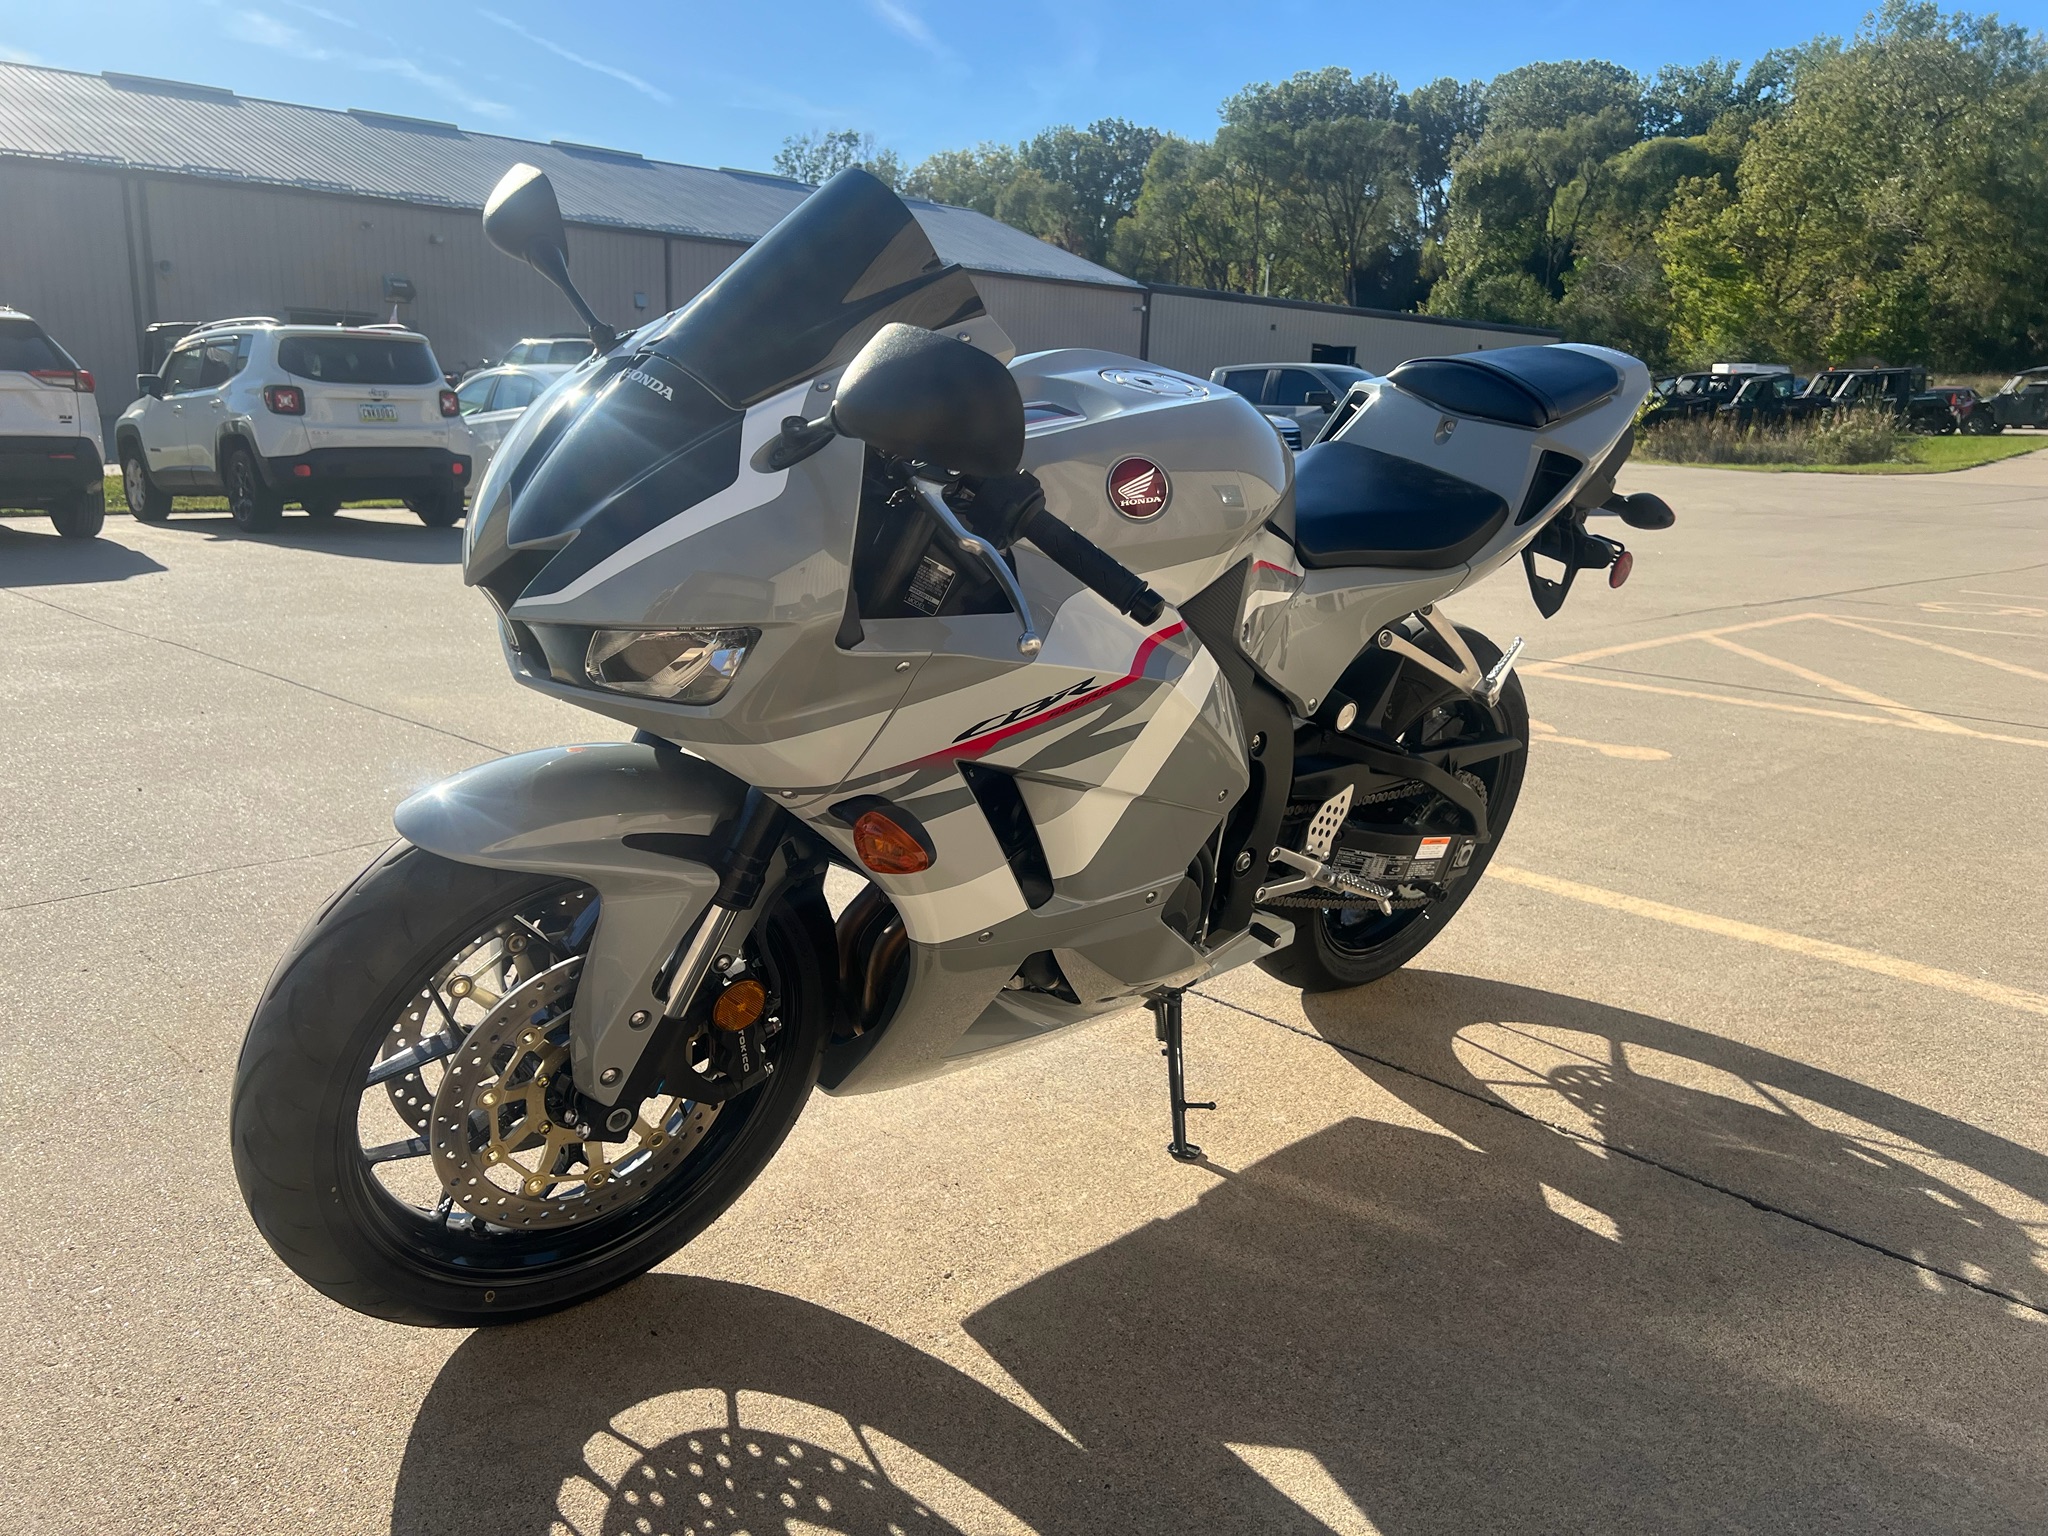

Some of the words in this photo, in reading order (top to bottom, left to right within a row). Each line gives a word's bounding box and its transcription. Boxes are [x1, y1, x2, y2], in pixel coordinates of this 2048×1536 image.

[623, 367, 674, 402] HONDA
[1120, 496, 1162, 507] HONDA
[951, 675, 1102, 744] CBR
[738, 1029, 750, 1073] TOKICO
